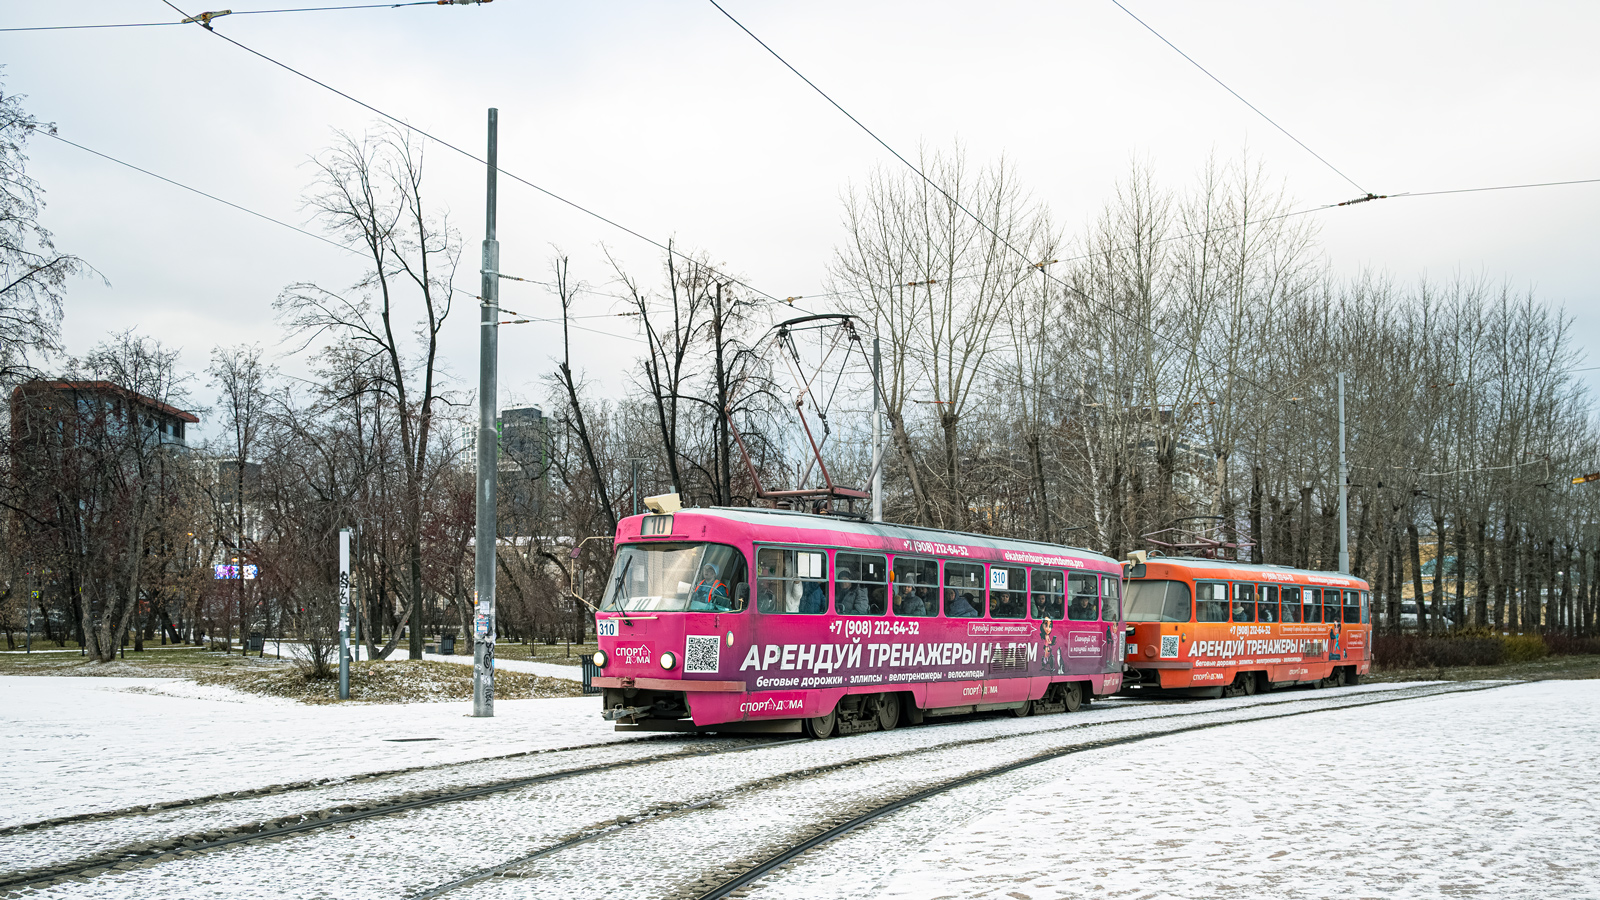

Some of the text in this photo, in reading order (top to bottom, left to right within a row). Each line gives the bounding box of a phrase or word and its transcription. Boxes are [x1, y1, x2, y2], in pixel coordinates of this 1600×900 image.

[651, 516, 666, 534] 10
[903, 540, 969, 556] +7 (908) 212-64-32
[993, 571, 1006, 583] 310
[599, 623, 615, 635] 310
[829, 620, 919, 638] +7 (908) 212-64-32
[1229, 625, 1236, 635] +7
[615, 647, 643, 656] СПОРТ
[1187, 636, 1245, 659] АРЕНДУЙ
[1246, 639, 1298, 656] ТРЕНАЖЕРЫ
[1300, 639, 1312, 653] НА
[739, 637, 862, 674] АРЕНДУЙ
[867, 643, 977, 667] ТРЕНАЖЕРЫ
[980, 642, 1003, 664] НА
[756, 670, 984, 687] беговые дорожки эллипсы велотренажеры велосипеды
[963, 686, 979, 696] СПОРТ
[740, 701, 768, 712] СПОРТ
